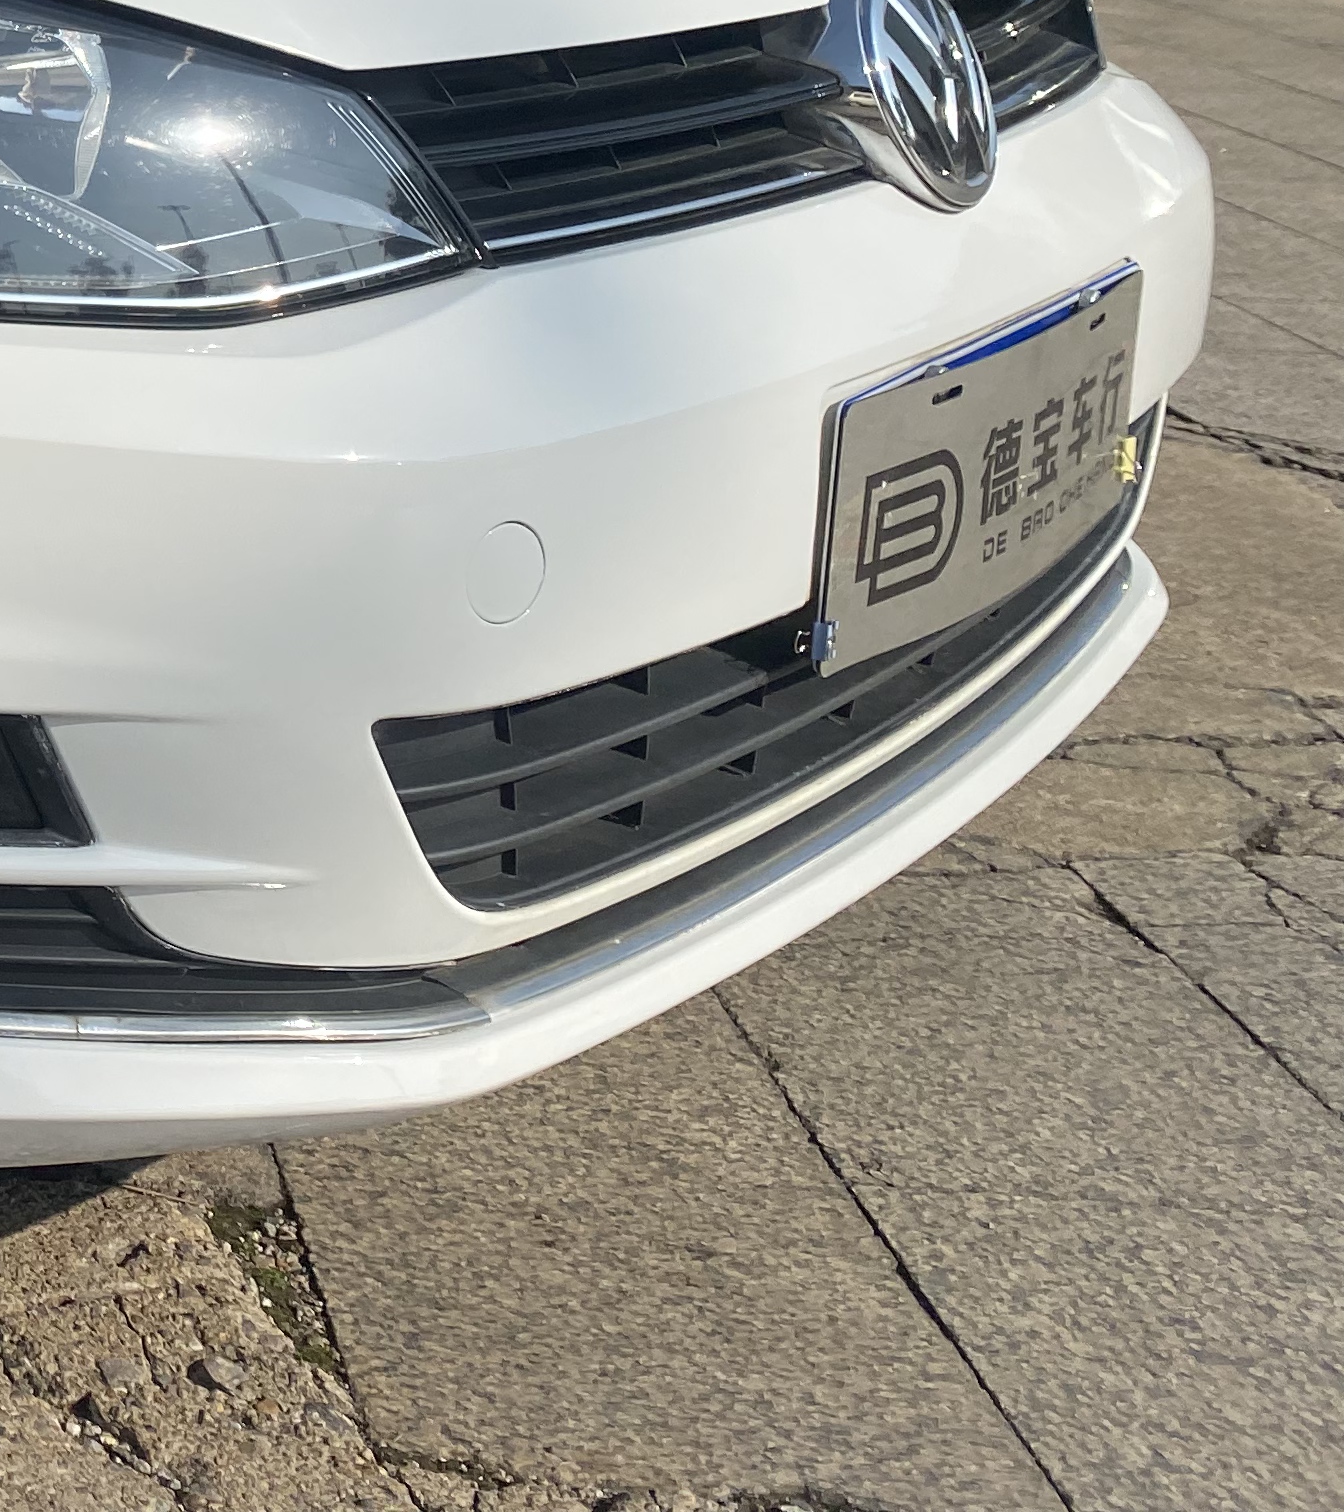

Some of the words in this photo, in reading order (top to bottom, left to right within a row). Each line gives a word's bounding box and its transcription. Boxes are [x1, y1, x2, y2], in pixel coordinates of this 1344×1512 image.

[979, 349, 1126, 526] 德宝车行
[982, 529, 1009, 563] DE
[1020, 499, 1055, 541] BAO
